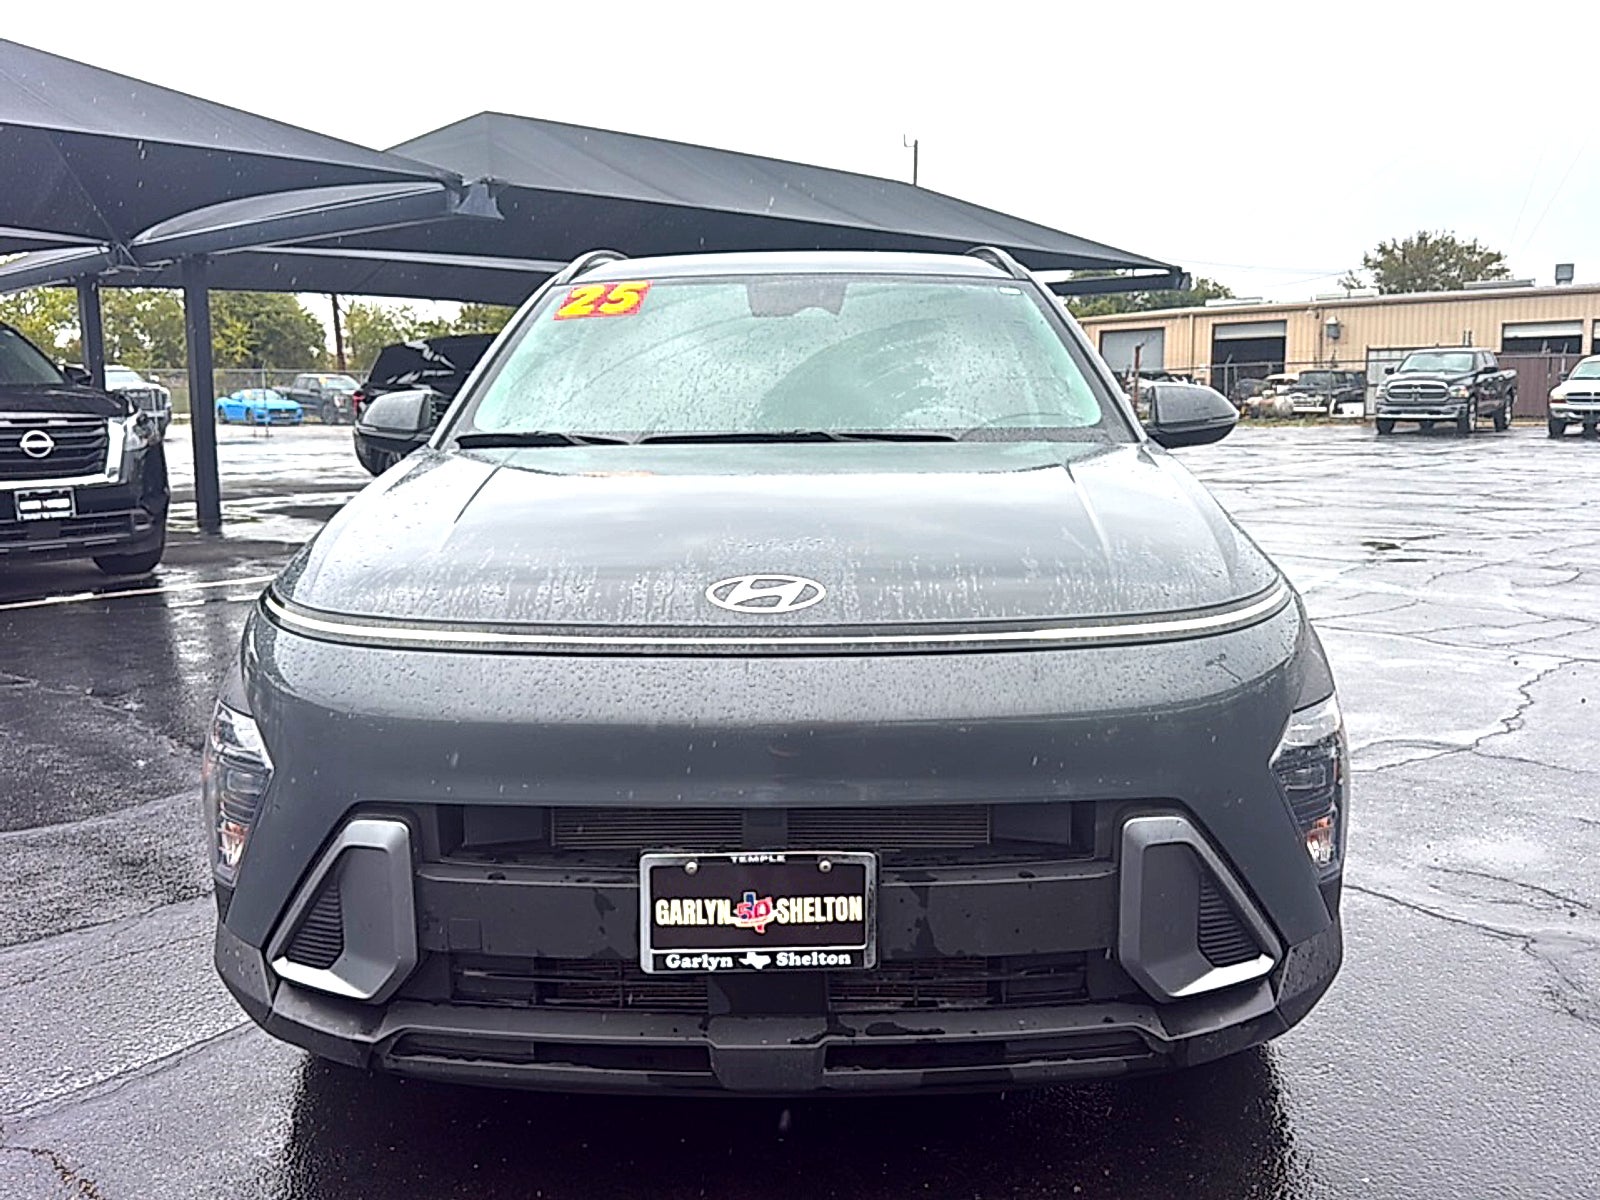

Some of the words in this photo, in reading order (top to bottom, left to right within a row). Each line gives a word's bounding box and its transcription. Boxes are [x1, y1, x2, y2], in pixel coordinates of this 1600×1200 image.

[558, 281, 648, 316] 25
[730, 855, 786, 863] TEMPLE
[655, 899, 733, 925] GARLYN
[736, 897, 772, 920] 50
[776, 896, 863, 924] SHELTON
[665, 954, 734, 971] Garlyn
[776, 952, 852, 967] Shelton
